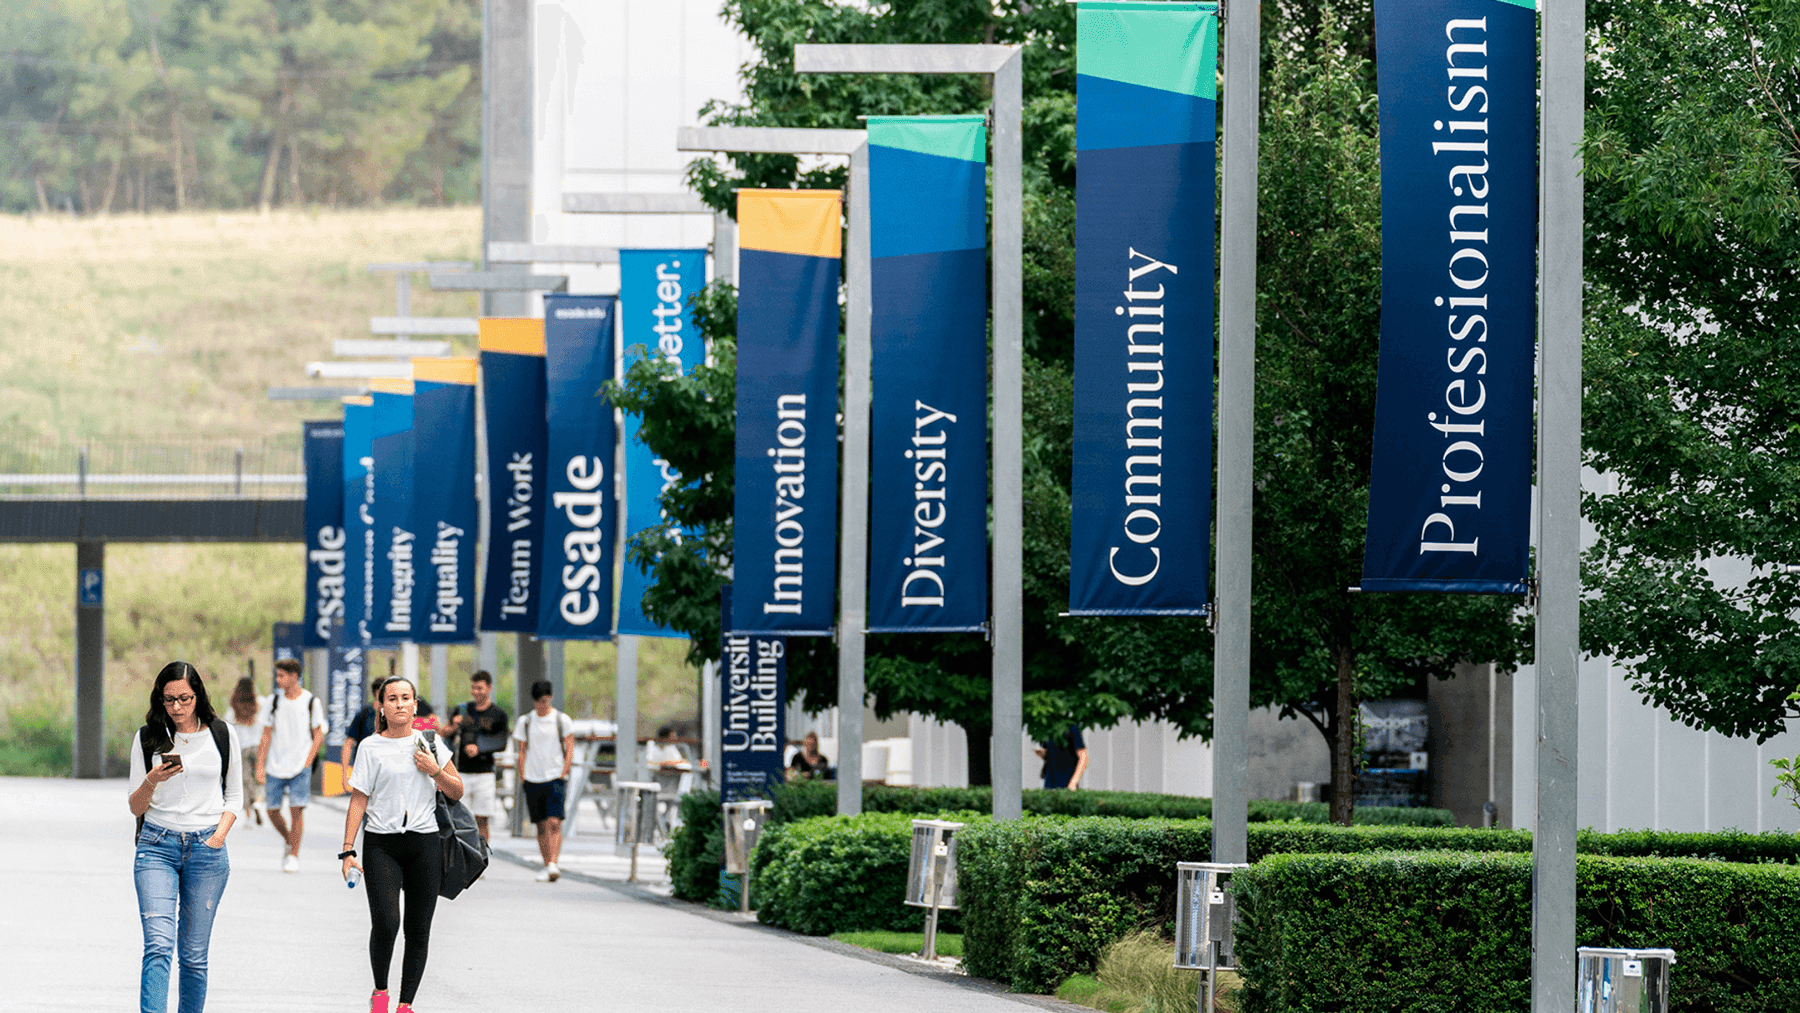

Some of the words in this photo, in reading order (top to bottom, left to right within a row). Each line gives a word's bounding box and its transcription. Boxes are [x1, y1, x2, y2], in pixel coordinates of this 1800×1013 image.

[1420, 16, 1488, 556] Professionalism
[1109, 247, 1177, 586] Community
[507, 452, 534, 533] Work
[553, 455, 604, 626] esade
[763, 394, 806, 615] Innovation
[901, 400, 957, 607] Diversity
[385, 526, 416, 631] Integrity
[430, 521, 464, 632] Equality
[501, 539, 532, 620] Team
[723, 636, 750, 752] Universit
[750, 639, 785, 752] Building
